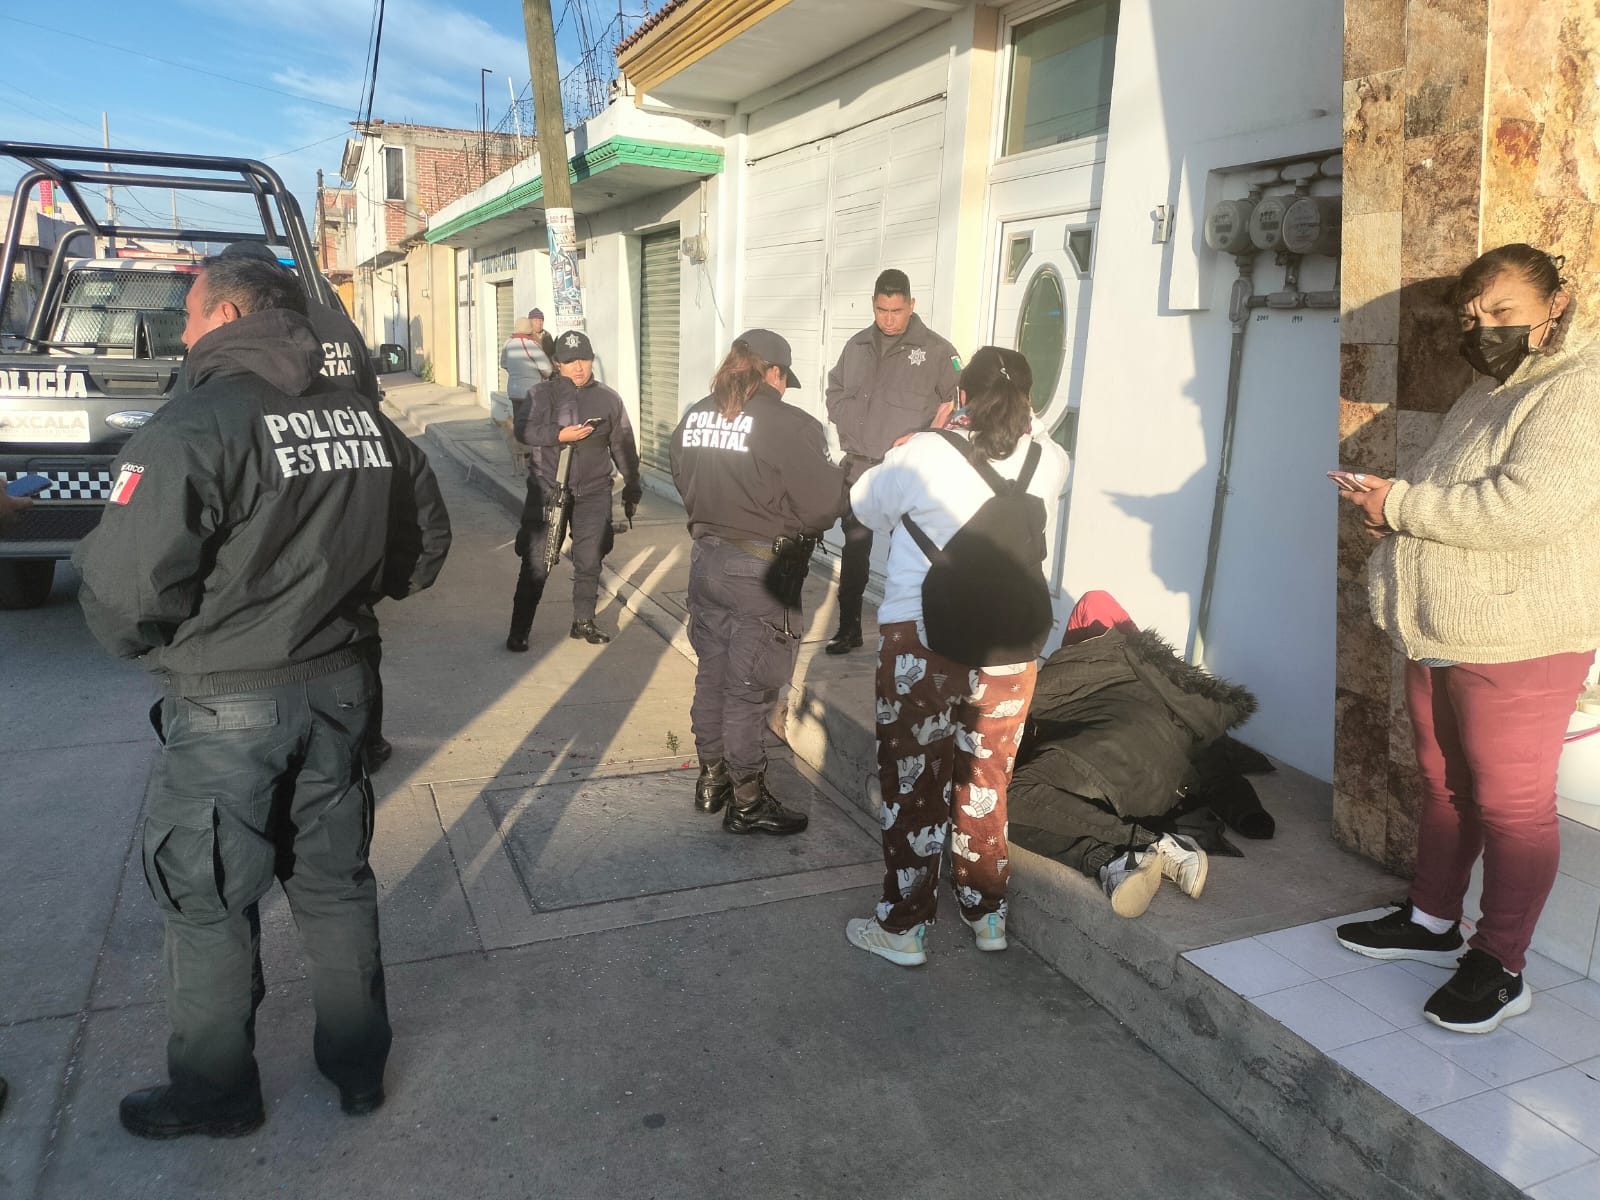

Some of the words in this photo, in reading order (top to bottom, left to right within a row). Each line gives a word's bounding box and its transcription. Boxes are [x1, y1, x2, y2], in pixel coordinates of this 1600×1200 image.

[263, 406, 382, 444] POLICÍA
[682, 428, 749, 452] ESTATAL
[274, 440, 393, 479] ESTATAL
